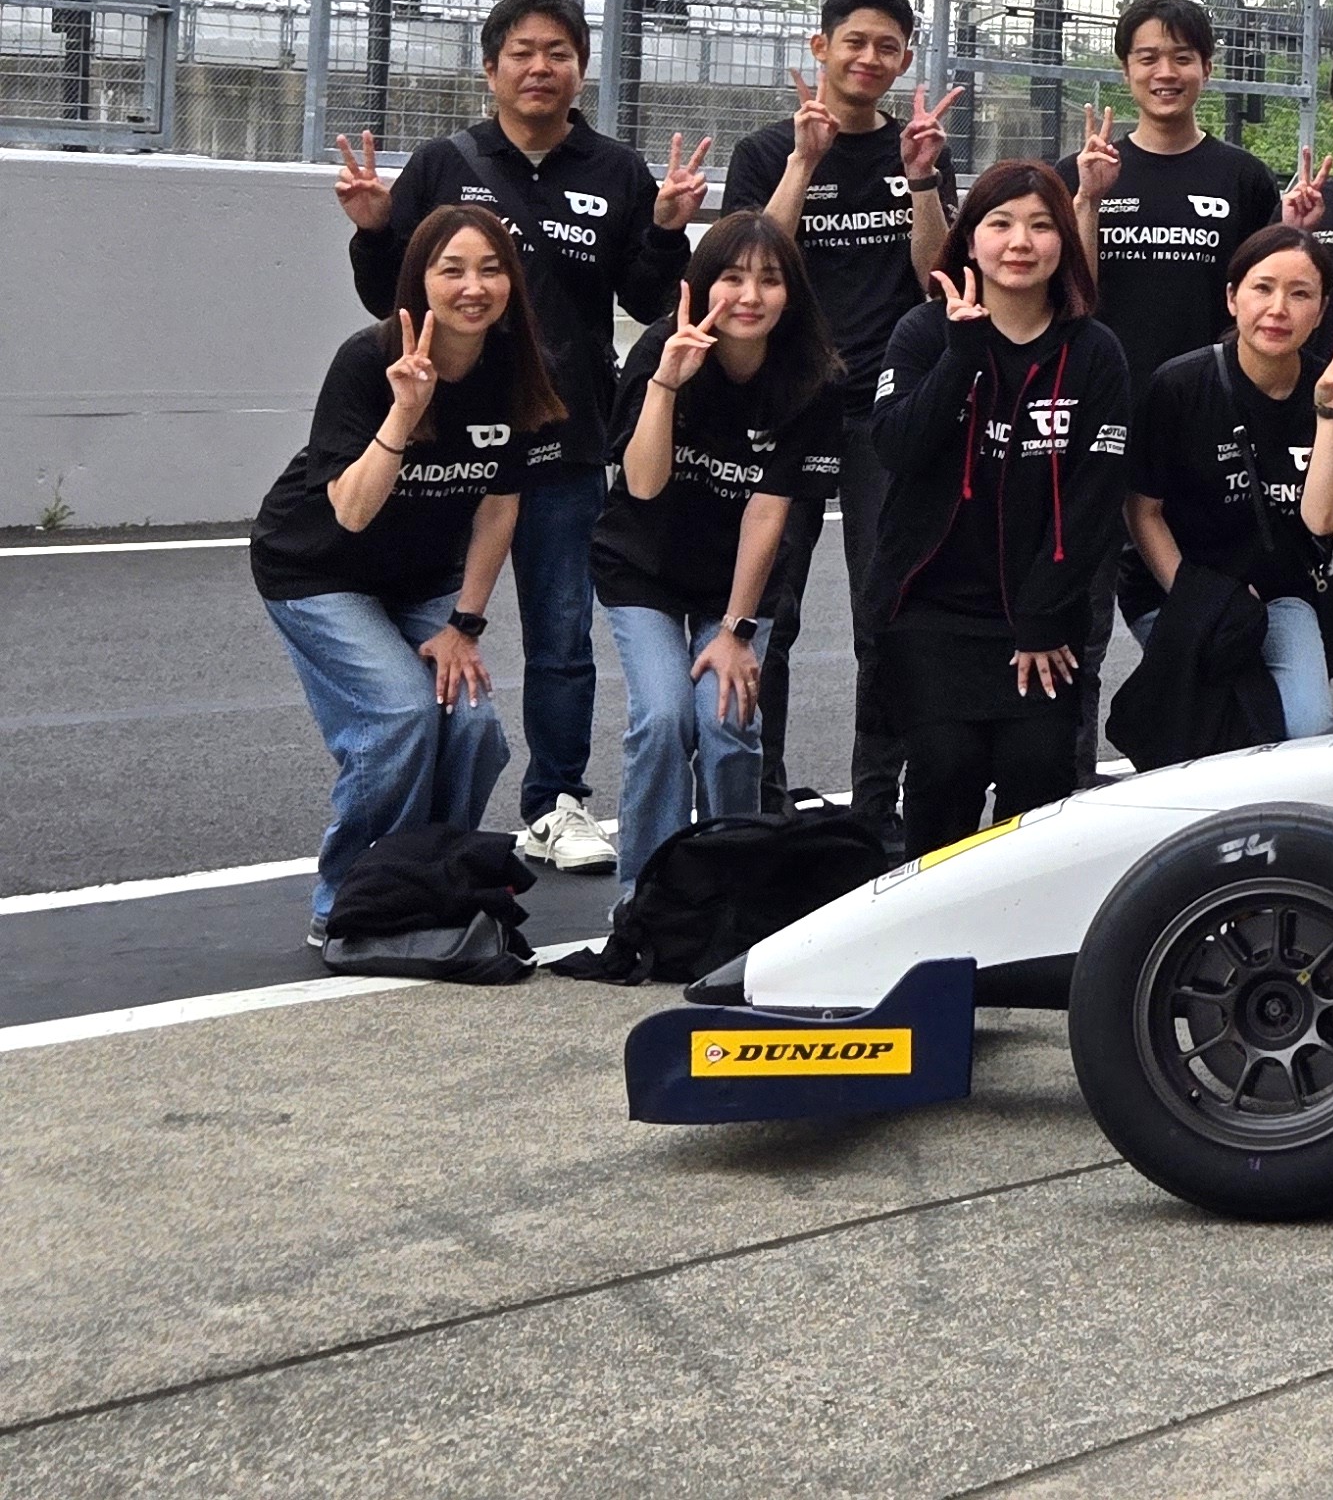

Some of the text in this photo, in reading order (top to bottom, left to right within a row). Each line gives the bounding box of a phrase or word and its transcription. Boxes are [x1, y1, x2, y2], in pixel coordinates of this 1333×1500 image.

[1099, 226, 1220, 248] TOKAIDENSO
[1100, 251, 1147, 260] OPTICAL
[733, 1042, 894, 1062] DUNLOP
